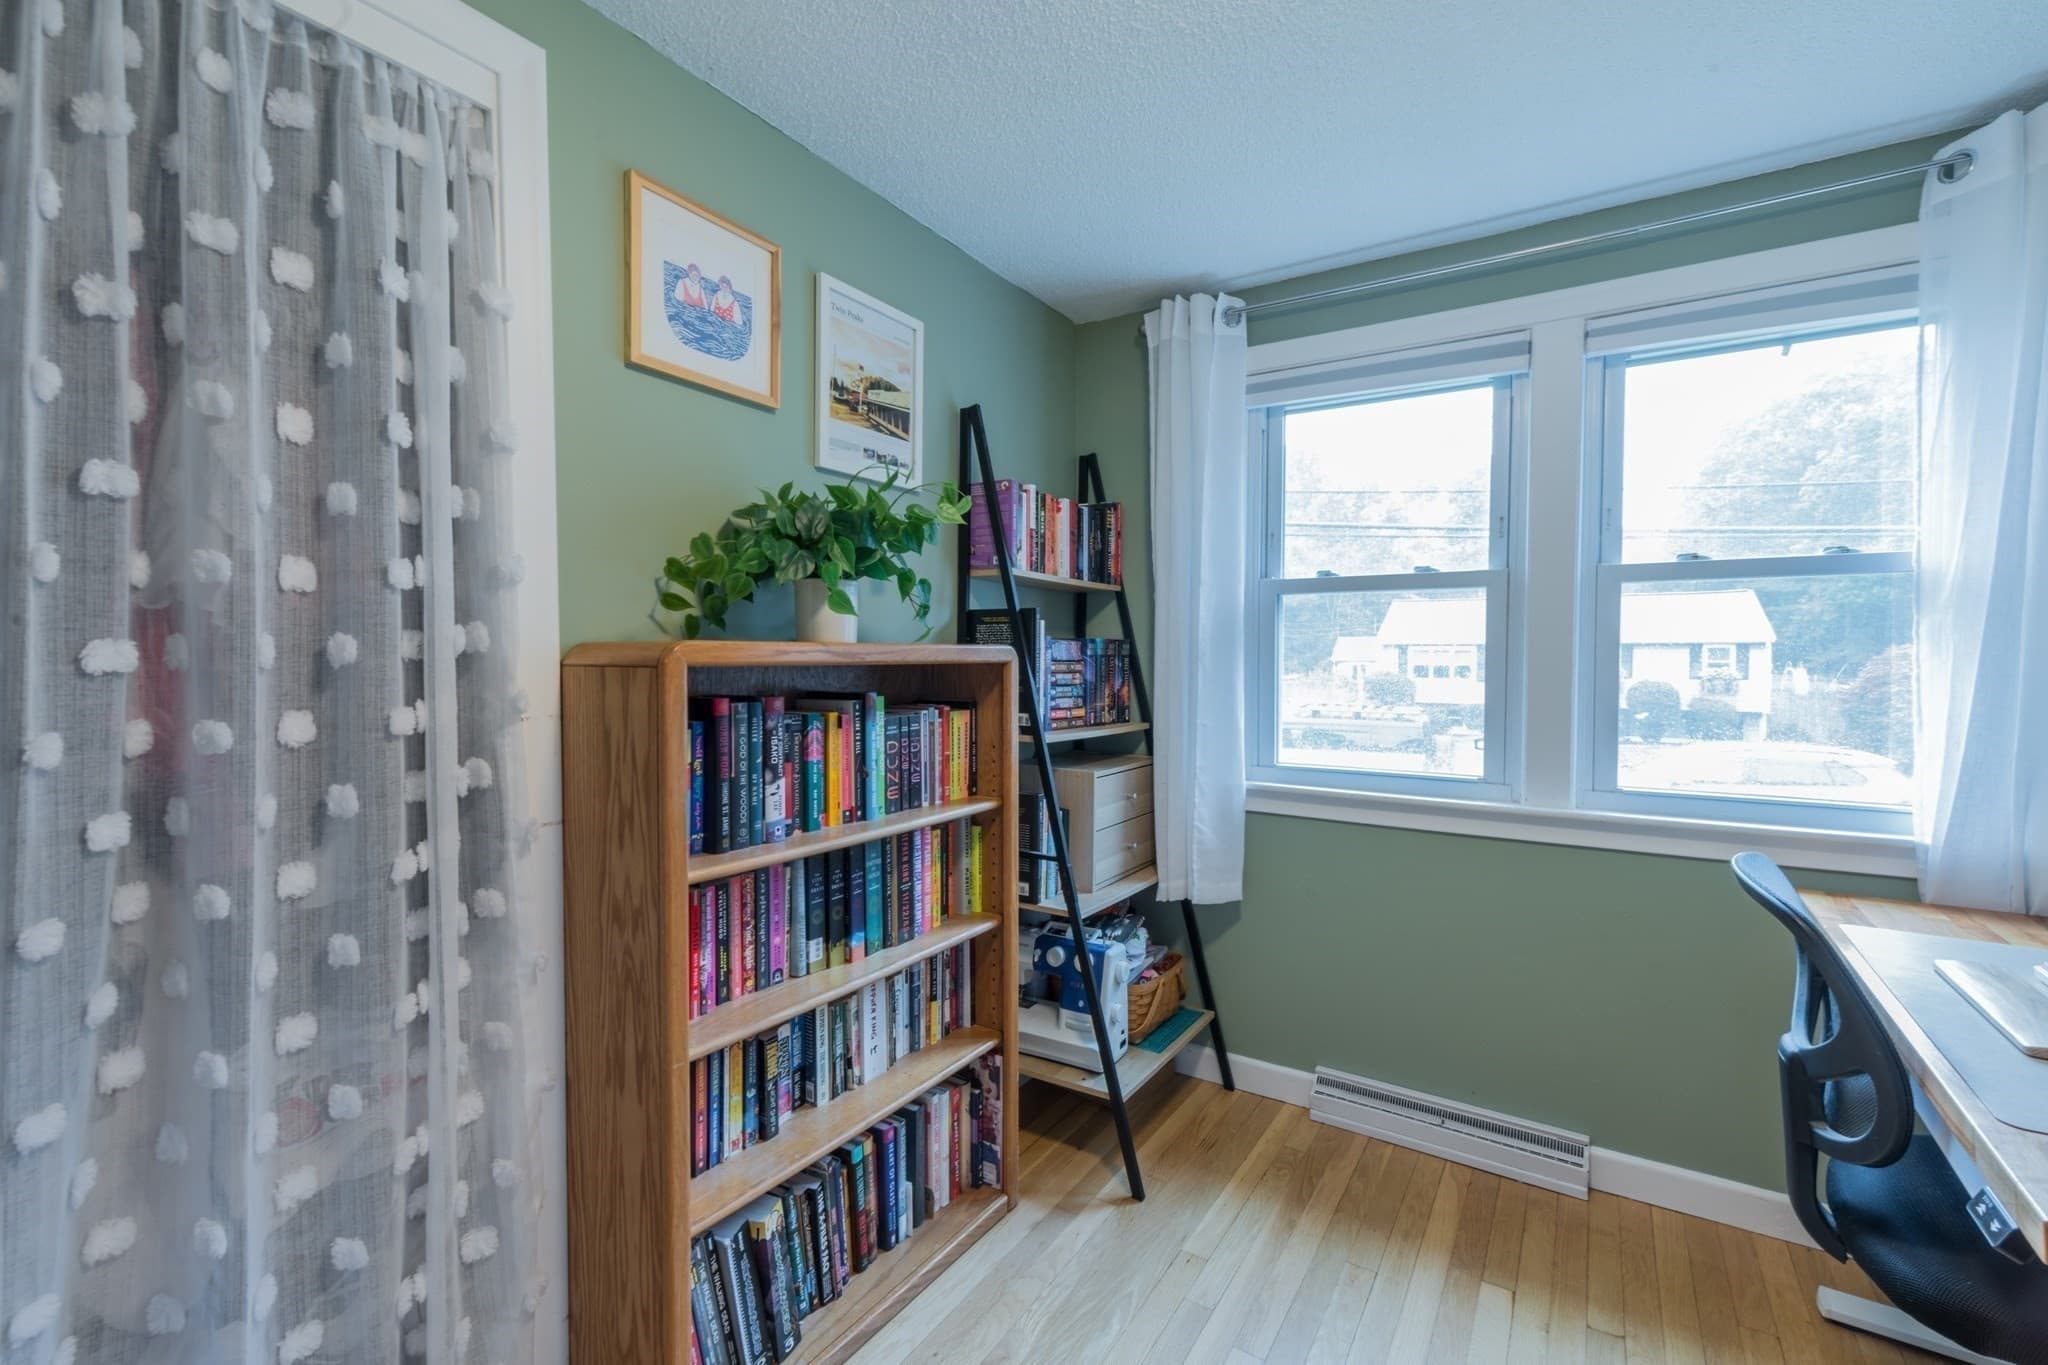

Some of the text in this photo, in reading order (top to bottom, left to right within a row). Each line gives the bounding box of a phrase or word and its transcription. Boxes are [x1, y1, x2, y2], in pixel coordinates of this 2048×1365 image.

[831, 302, 864, 323] Twin Peaks
[720, 720, 730, 779] MURDER ROAD
[901, 738, 909, 769] DUNE
[911, 743, 920, 783] DUNE
[887, 741, 900, 800] DUNE
[738, 788, 747, 825] WOODS
[870, 1015, 878, 1041] KING
[817, 1191, 825, 1212] THE
[822, 1251, 830, 1273] FAQ
[710, 1253, 719, 1273] THE
[720, 1311, 731, 1335] DEAD
[709, 1319, 720, 1344] DEAD
